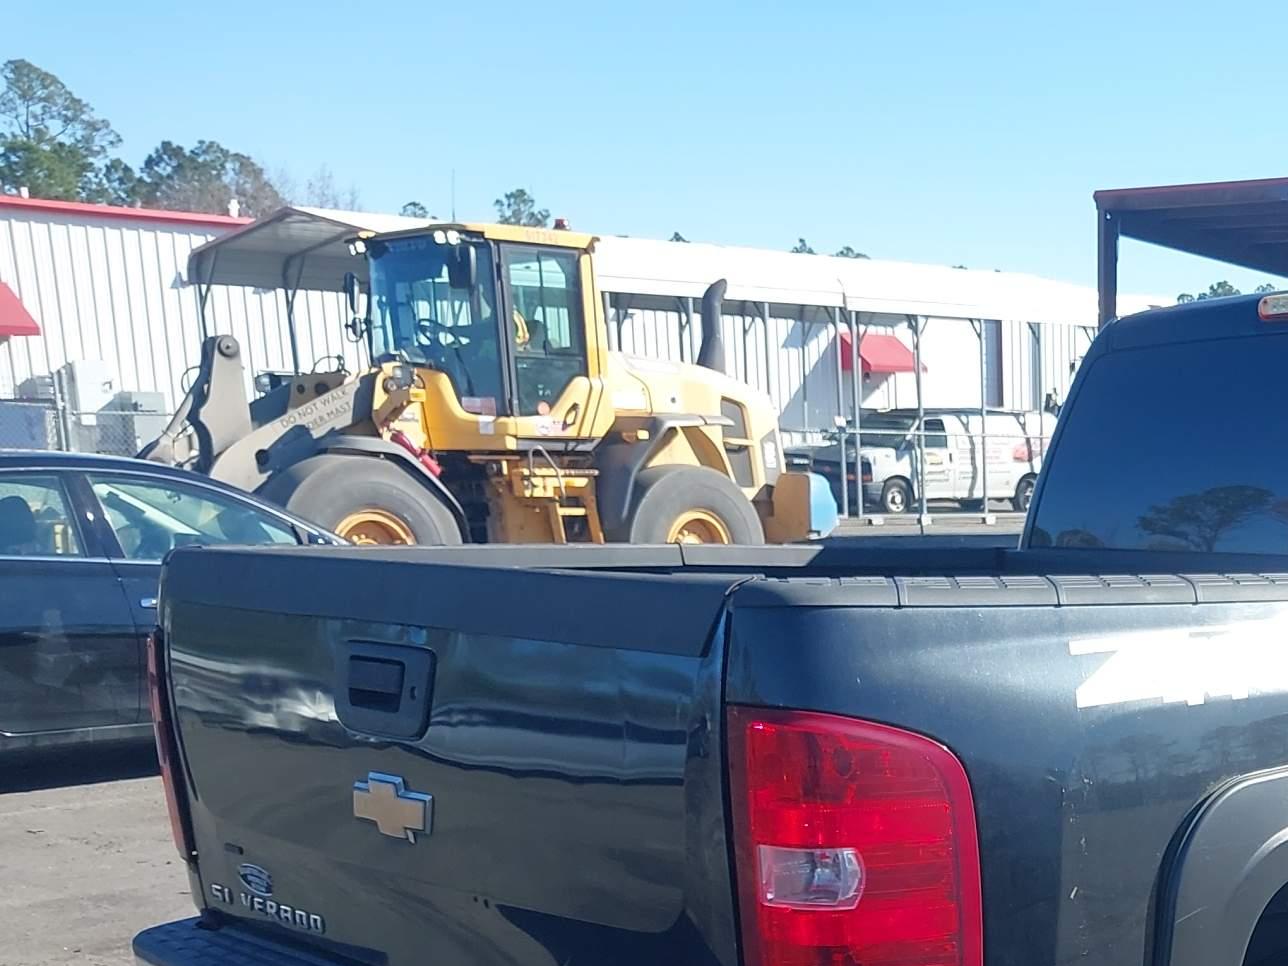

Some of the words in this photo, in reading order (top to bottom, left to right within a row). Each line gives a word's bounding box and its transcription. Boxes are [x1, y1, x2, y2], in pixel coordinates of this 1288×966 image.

[280, 415, 297, 429] DO
[297, 402, 319, 418] NOT
[320, 388, 348, 407] WALK
[326, 401, 352, 419] MAST
